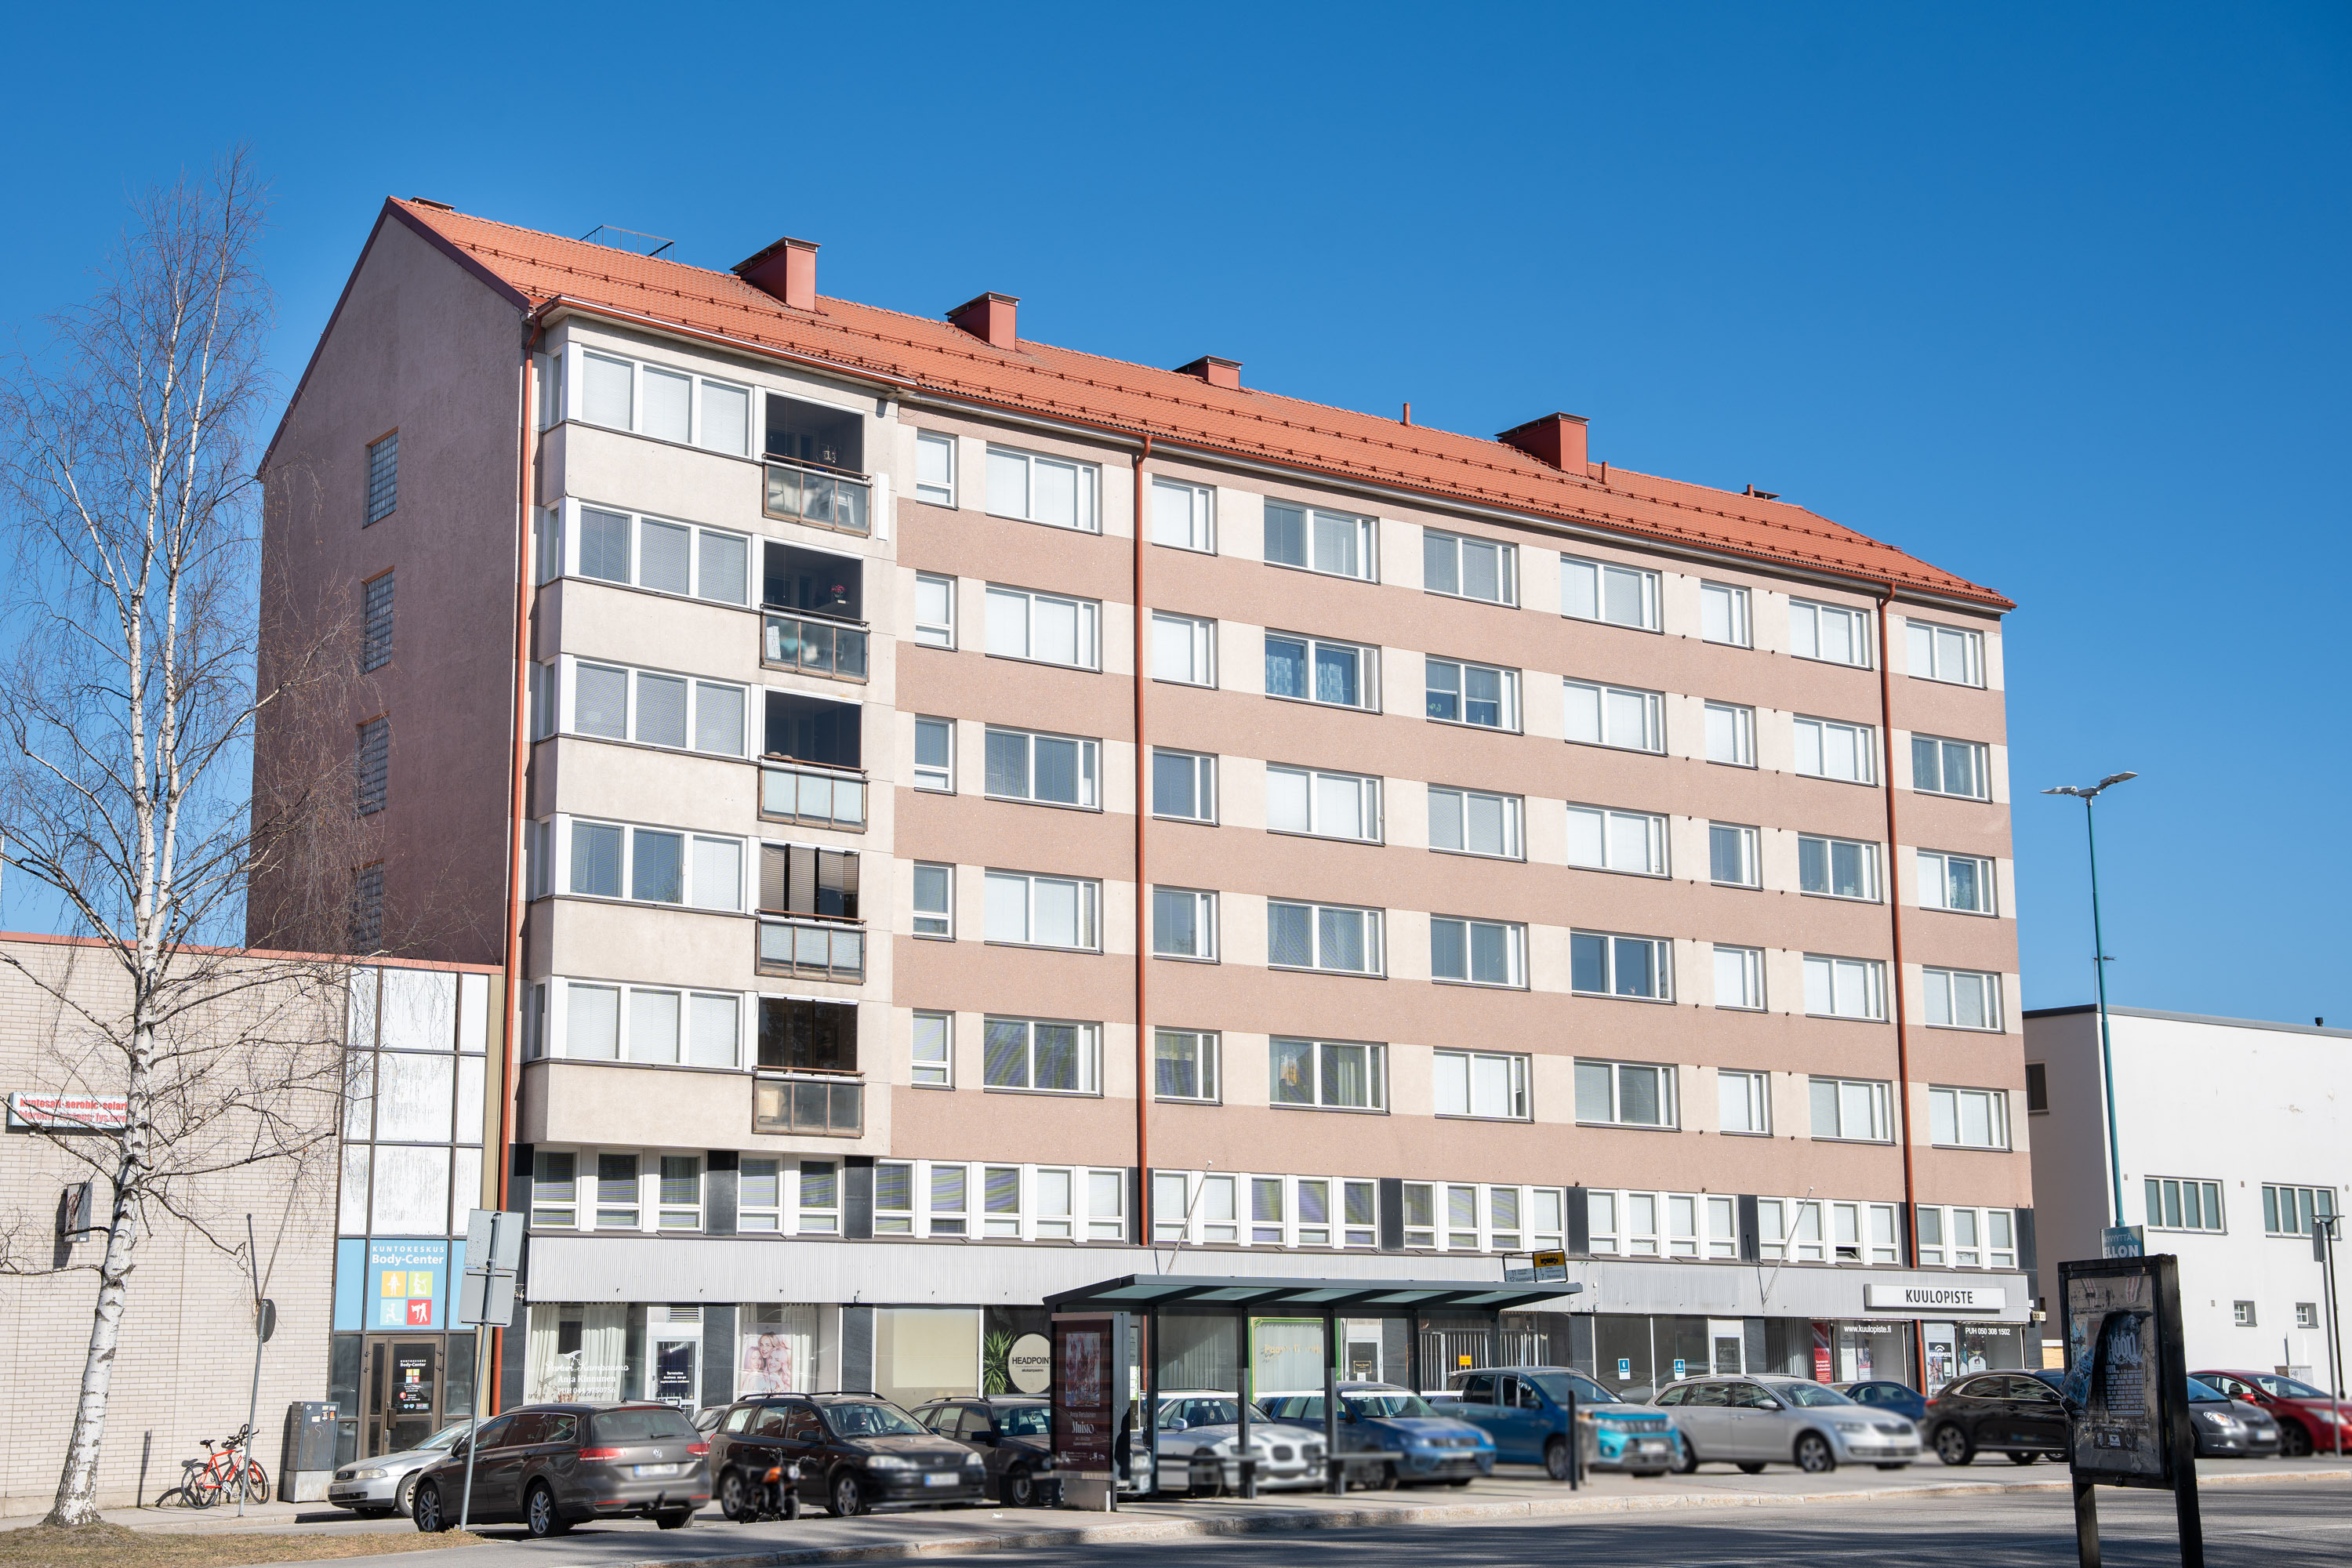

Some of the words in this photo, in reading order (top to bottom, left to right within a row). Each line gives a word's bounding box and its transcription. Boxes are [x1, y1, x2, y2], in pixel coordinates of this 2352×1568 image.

[65, 1100, 99, 1109] aerobic
[372, 1254, 445, 1266] Body-Center
[1906, 1289, 1973, 1304] KUULOPISTE
[1844, 1325, 1892, 1334] www.kuulopiste.fi
[1072, 1421, 1094, 1434] Muisto
